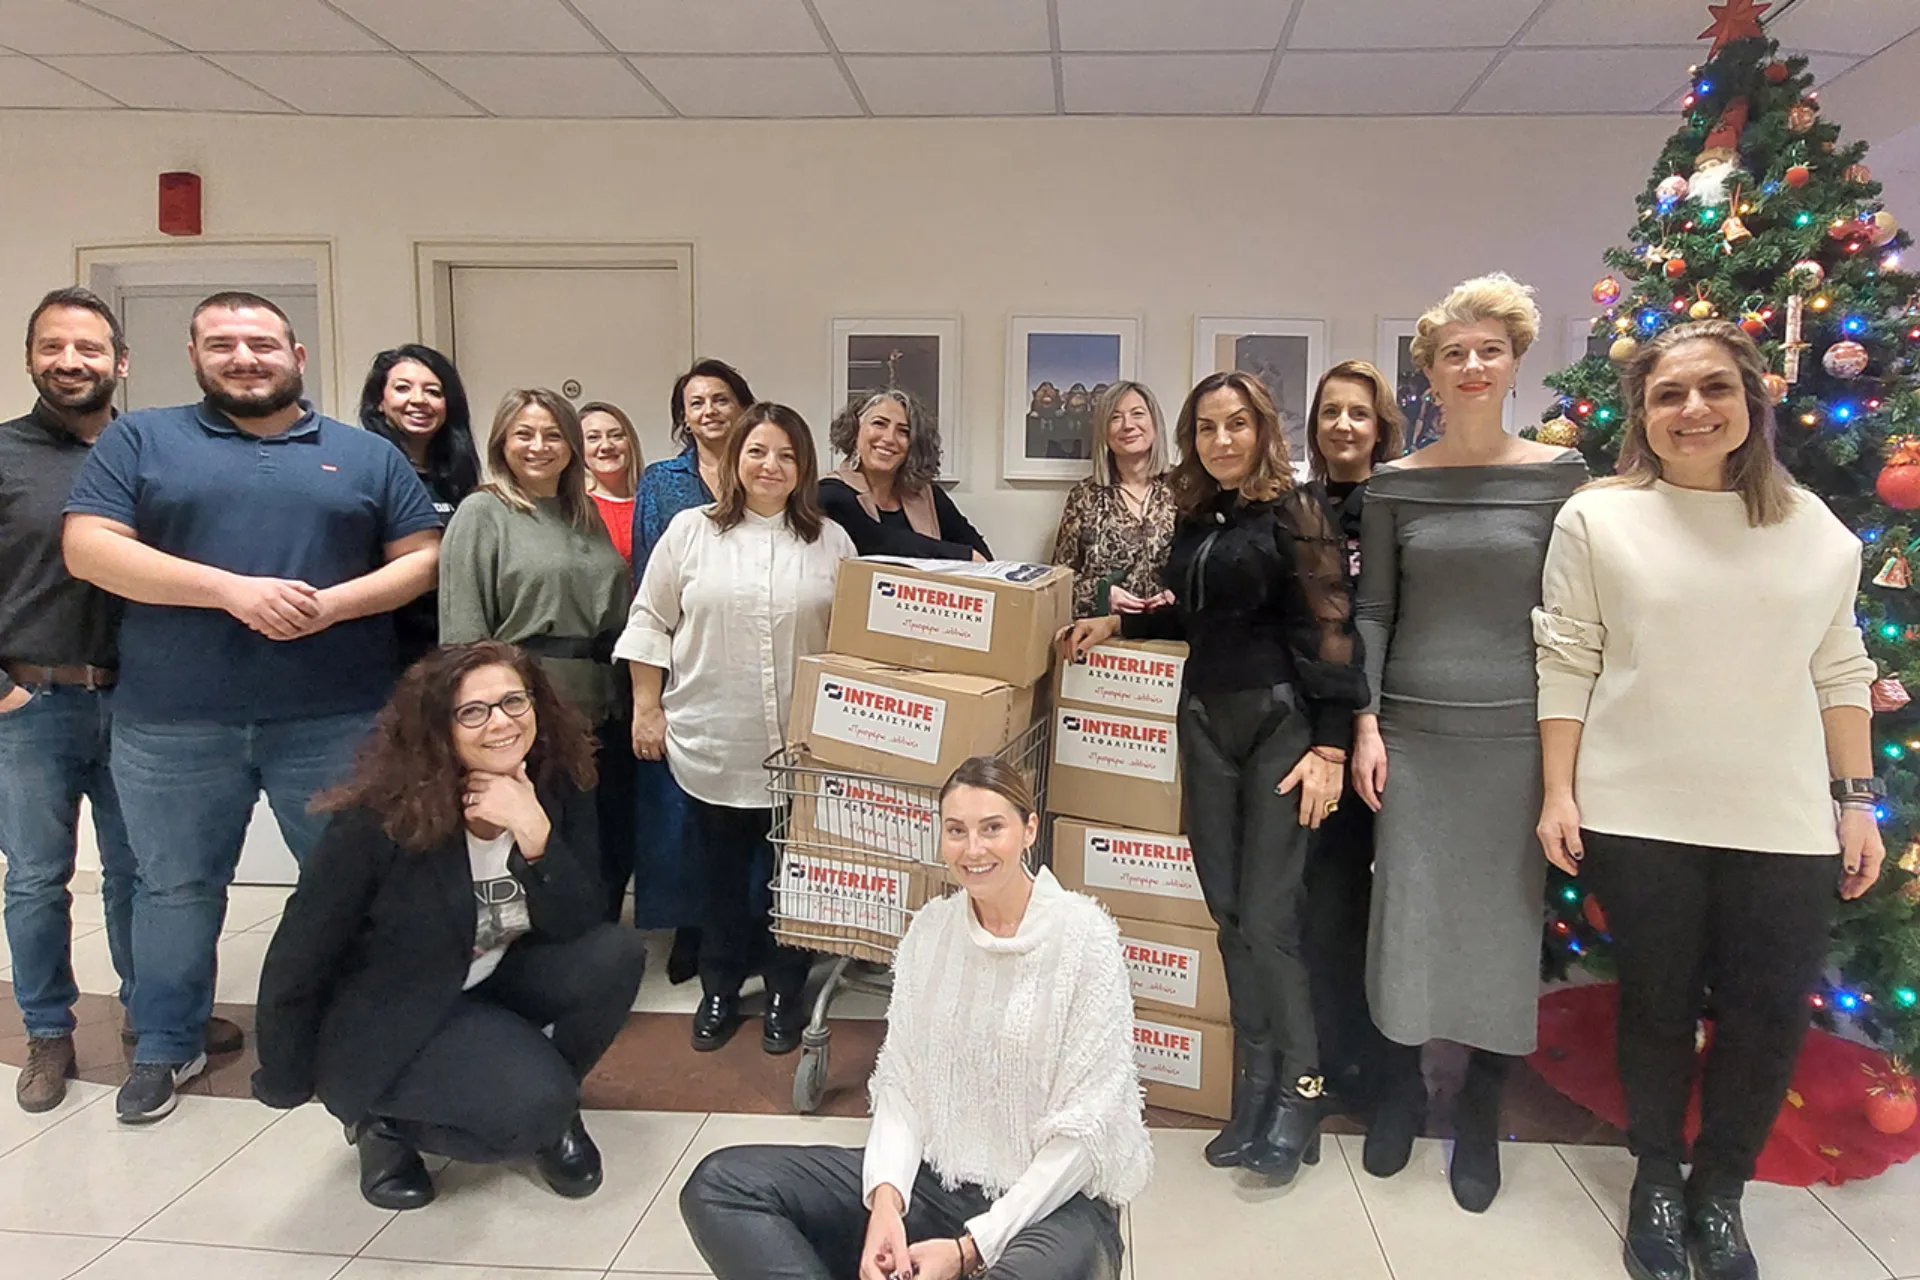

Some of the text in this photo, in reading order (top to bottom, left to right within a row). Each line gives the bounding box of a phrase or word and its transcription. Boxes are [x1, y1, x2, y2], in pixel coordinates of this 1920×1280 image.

[897, 584, 983, 613] INTERLIFE
[896, 602, 982, 623] ΑΣΦΑΛΙΣΤΙΚΗ
[1088, 652, 1175, 678] INTERLIFE
[1088, 670, 1174, 688] ΑΣΦΑΛΙΣΤΙΚΗ
[844, 687, 933, 721] INTERLIFE
[843, 706, 931, 732] ΑΣΦΑΛΙΣΤΙΚΗ
[1082, 718, 1168, 744] INTERLIFE
[1082, 736, 1167, 754] ΑΣΦΑΛΙΣΤΙΚΗ
[1112, 839, 1192, 862] INTERLIF
[1112, 856, 1193, 872] ΑΣΦΑΛΙΣΤΙΚ
[807, 865, 897, 894] INTERLIFE
[1122, 944, 1188, 970] ERLIFE
[1133, 1027, 1190, 1051] ERLIFE
